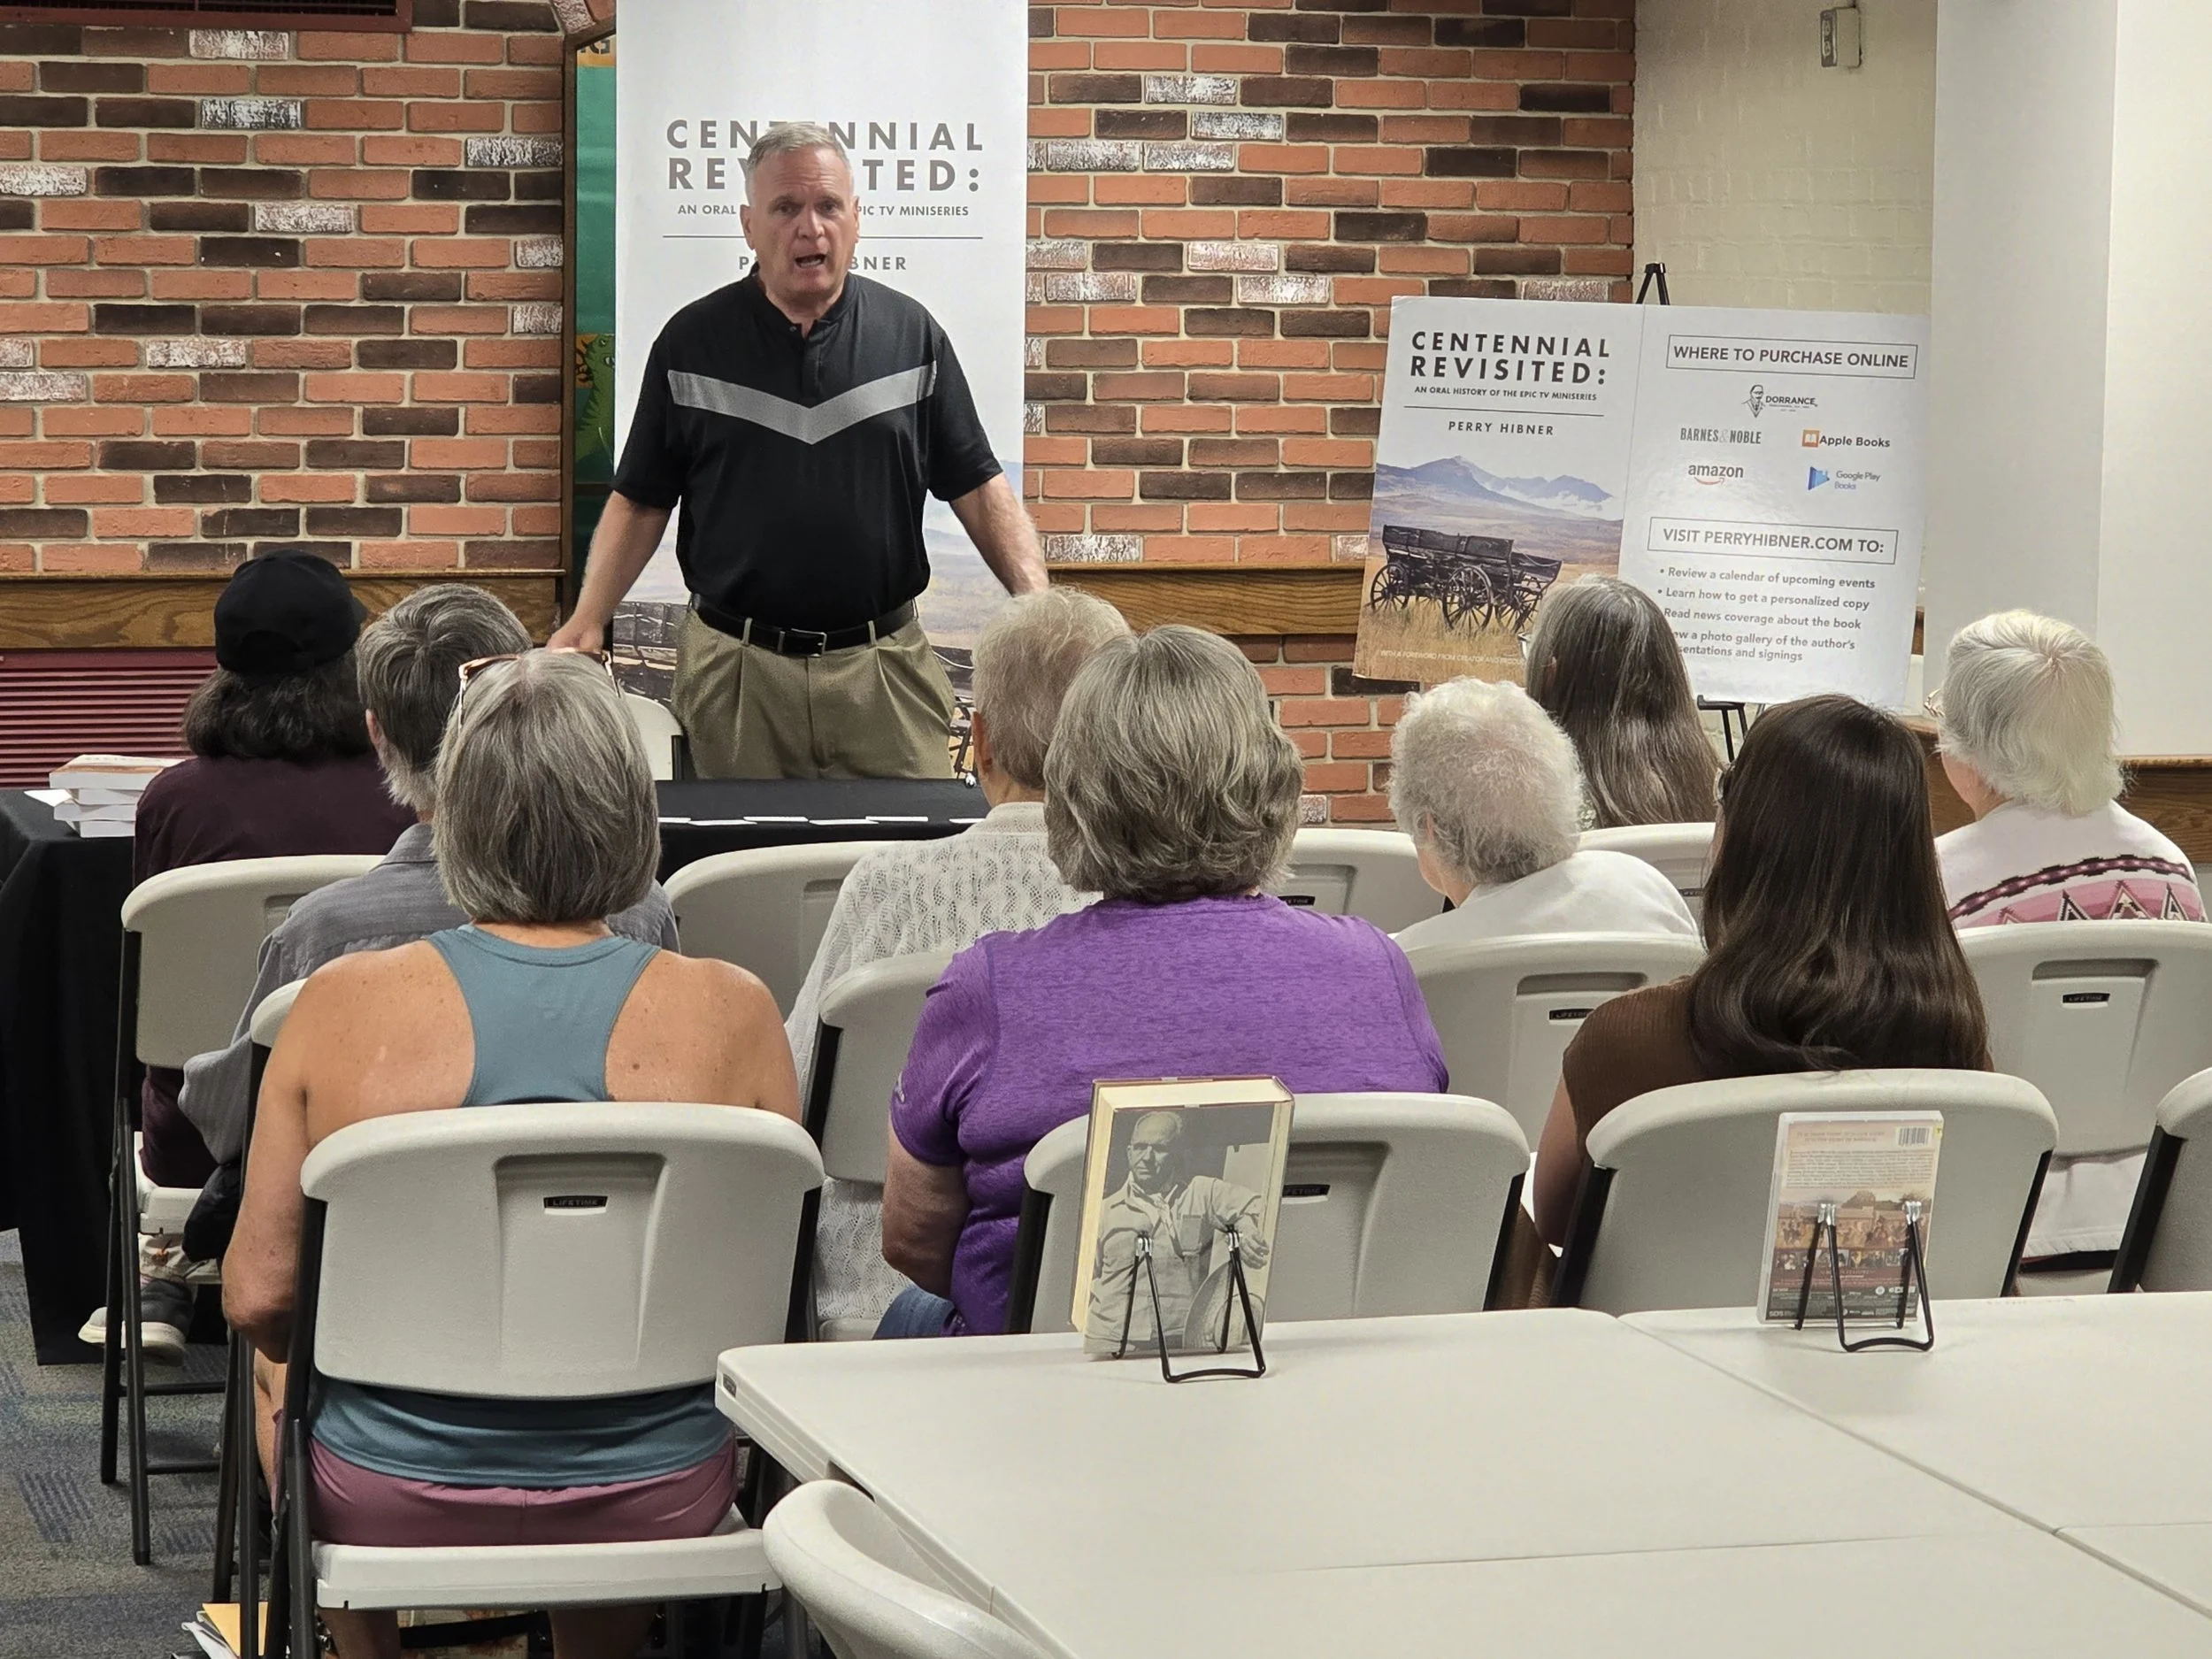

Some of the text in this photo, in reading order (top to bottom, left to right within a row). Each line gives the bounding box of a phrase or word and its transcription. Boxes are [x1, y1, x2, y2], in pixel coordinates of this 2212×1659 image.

[666, 119, 982, 150] CENNNIAL
[669, 157, 979, 192] RETED:
[678, 204, 736, 214] AN ORAL
[879, 205, 895, 216] TV
[899, 205, 969, 216] MINISERIES
[850, 257, 906, 270] BNER
[1411, 331, 1609, 357] CENTENNIAL
[1674, 346, 1909, 368] WHERE TO PURCHASE ONLINE
[1410, 356, 1606, 385] REVISITED:
[1453, 388, 1487, 396] HISTORY
[1552, 392, 1597, 401] MINISERIES
[1765, 396, 1816, 404] DORRANCE
[1448, 421, 1554, 435] PERRY HIBNER
[1680, 427, 1719, 442] BARNES
[1730, 430, 1762, 444] NOBLE
[1819, 435, 1891, 448] Apple Books
[1688, 465, 1744, 479] amazon
[1836, 471, 1881, 482] Google Play
[1834, 481, 1856, 490] Books
[1663, 528, 1885, 553] VISIT PERRYHIBNER.COM TO:
[1668, 566, 1708, 579] Review
[1719, 570, 1765, 581] calendar
[1768, 572, 1780, 583] of
[1782, 575, 1836, 588] upcoming
[1839, 580, 1876, 588] events
[1666, 588, 1695, 598] Learn
[1699, 589, 1722, 600] how
[1724, 592, 1736, 601] to
[1740, 594, 1758, 604] get
[1770, 595, 1840, 607] personalized
[1843, 600, 1870, 611] copy
[1664, 608, 1862, 629] Read news coverage about the book
[1701, 630, 1732, 642] photo
[1735, 633, 1773, 647] gallery
[1776, 635, 1787, 645] of
[1790, 636, 1808, 647] the
[1811, 638, 1855, 649] author's
[1679, 645, 1803, 663] entations and signings
